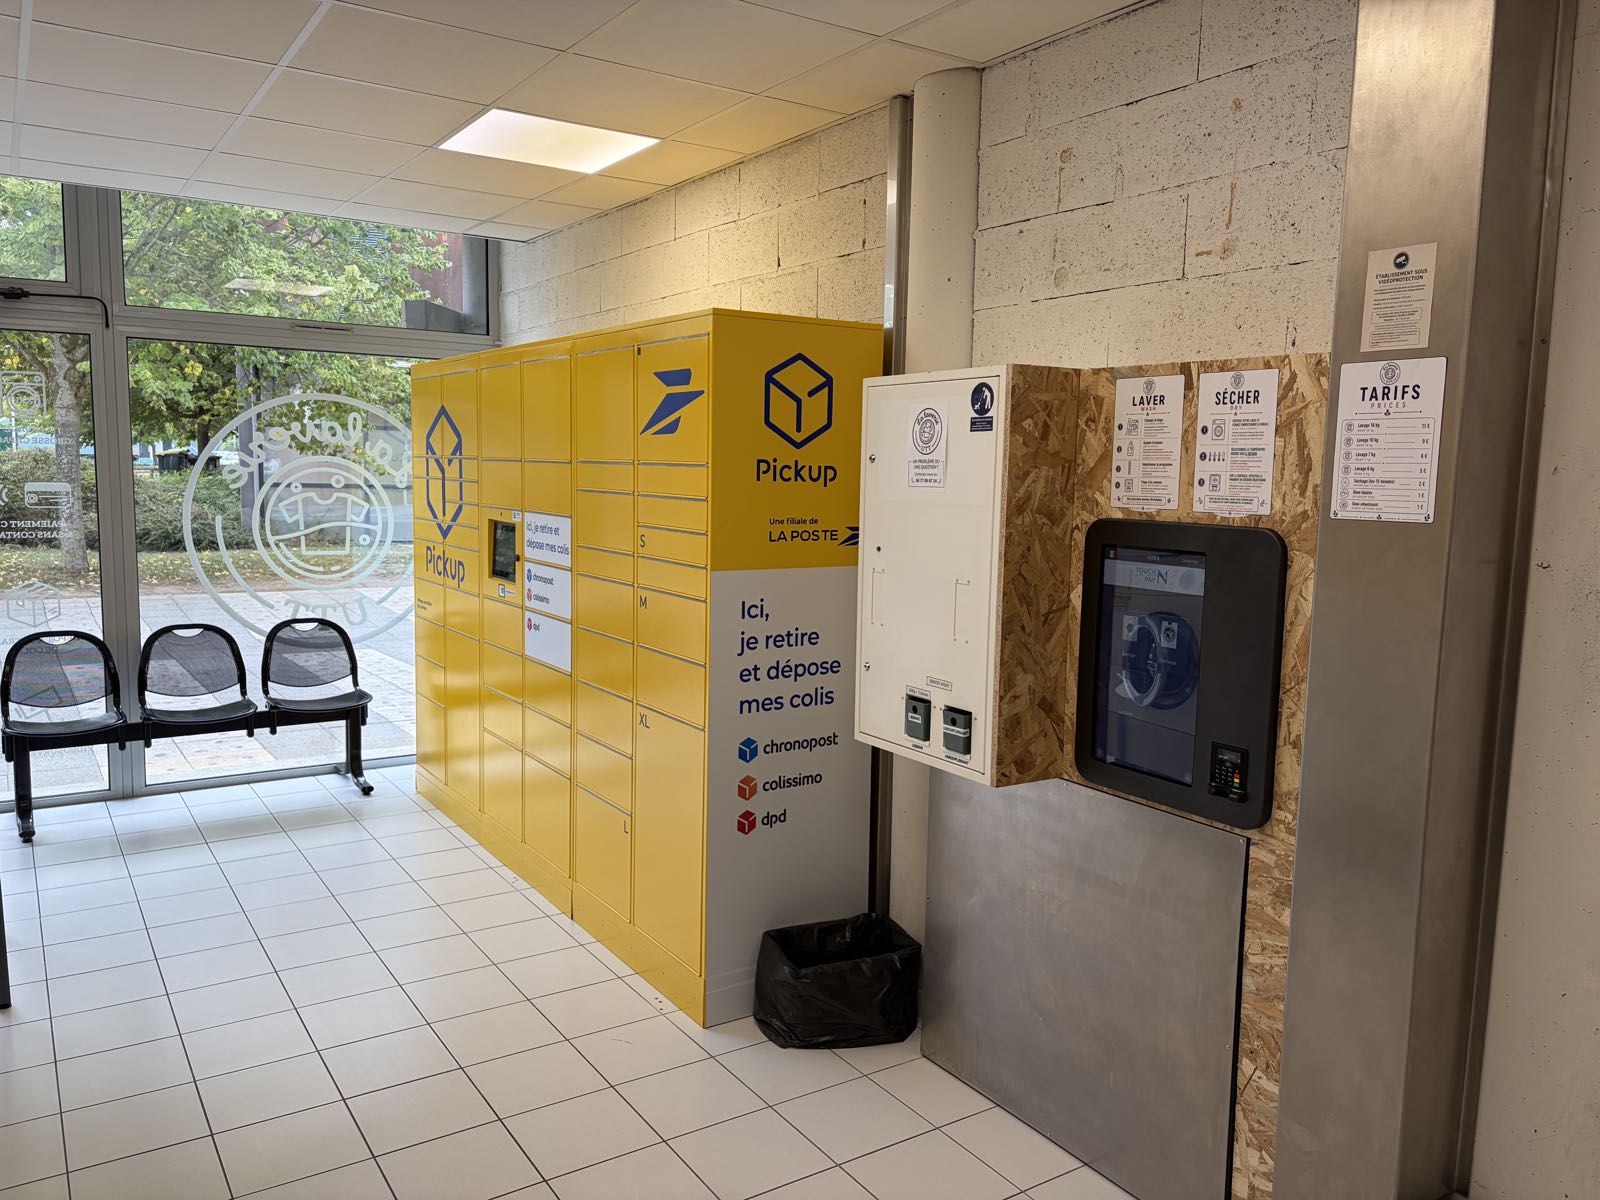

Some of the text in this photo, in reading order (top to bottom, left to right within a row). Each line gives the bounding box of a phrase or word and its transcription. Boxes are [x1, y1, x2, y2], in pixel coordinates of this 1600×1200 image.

[1376, 270, 1413, 280] ÉTABLISSEMENT
[1378, 275, 1424, 284] VIDÉOPROTECTION
[1132, 394, 1166, 407] LAVER
[1215, 388, 1260, 406] SÉCHER
[1360, 384, 1421, 402] TARIFS
[756, 458, 838, 488] Pickup
[533, 522, 539, 535] je
[539, 523, 553, 536] retire
[554, 526, 560, 537] et
[786, 517, 808, 525] filiale
[808, 517, 818, 525] de
[640, 534, 645, 548] S
[768, 528, 838, 542] LA POSTE
[526, 538, 570, 556] dépose mes colis
[426, 545, 465, 589] Pickup
[1136, 566, 1157, 576] TOUCH
[533, 573, 554, 586] chronopost
[533, 592, 550, 605] colissimo
[640, 596, 648, 610] M
[741, 598, 770, 622] Ici,
[736, 626, 820, 657] je retire
[739, 658, 842, 683] et dépose
[739, 686, 835, 715] mes colis
[639, 712, 650, 729] XL
[763, 732, 839, 755] chronopost
[762, 772, 822, 792] colissimo
[624, 820, 629, 834] L
[761, 808, 787, 829] dpd
